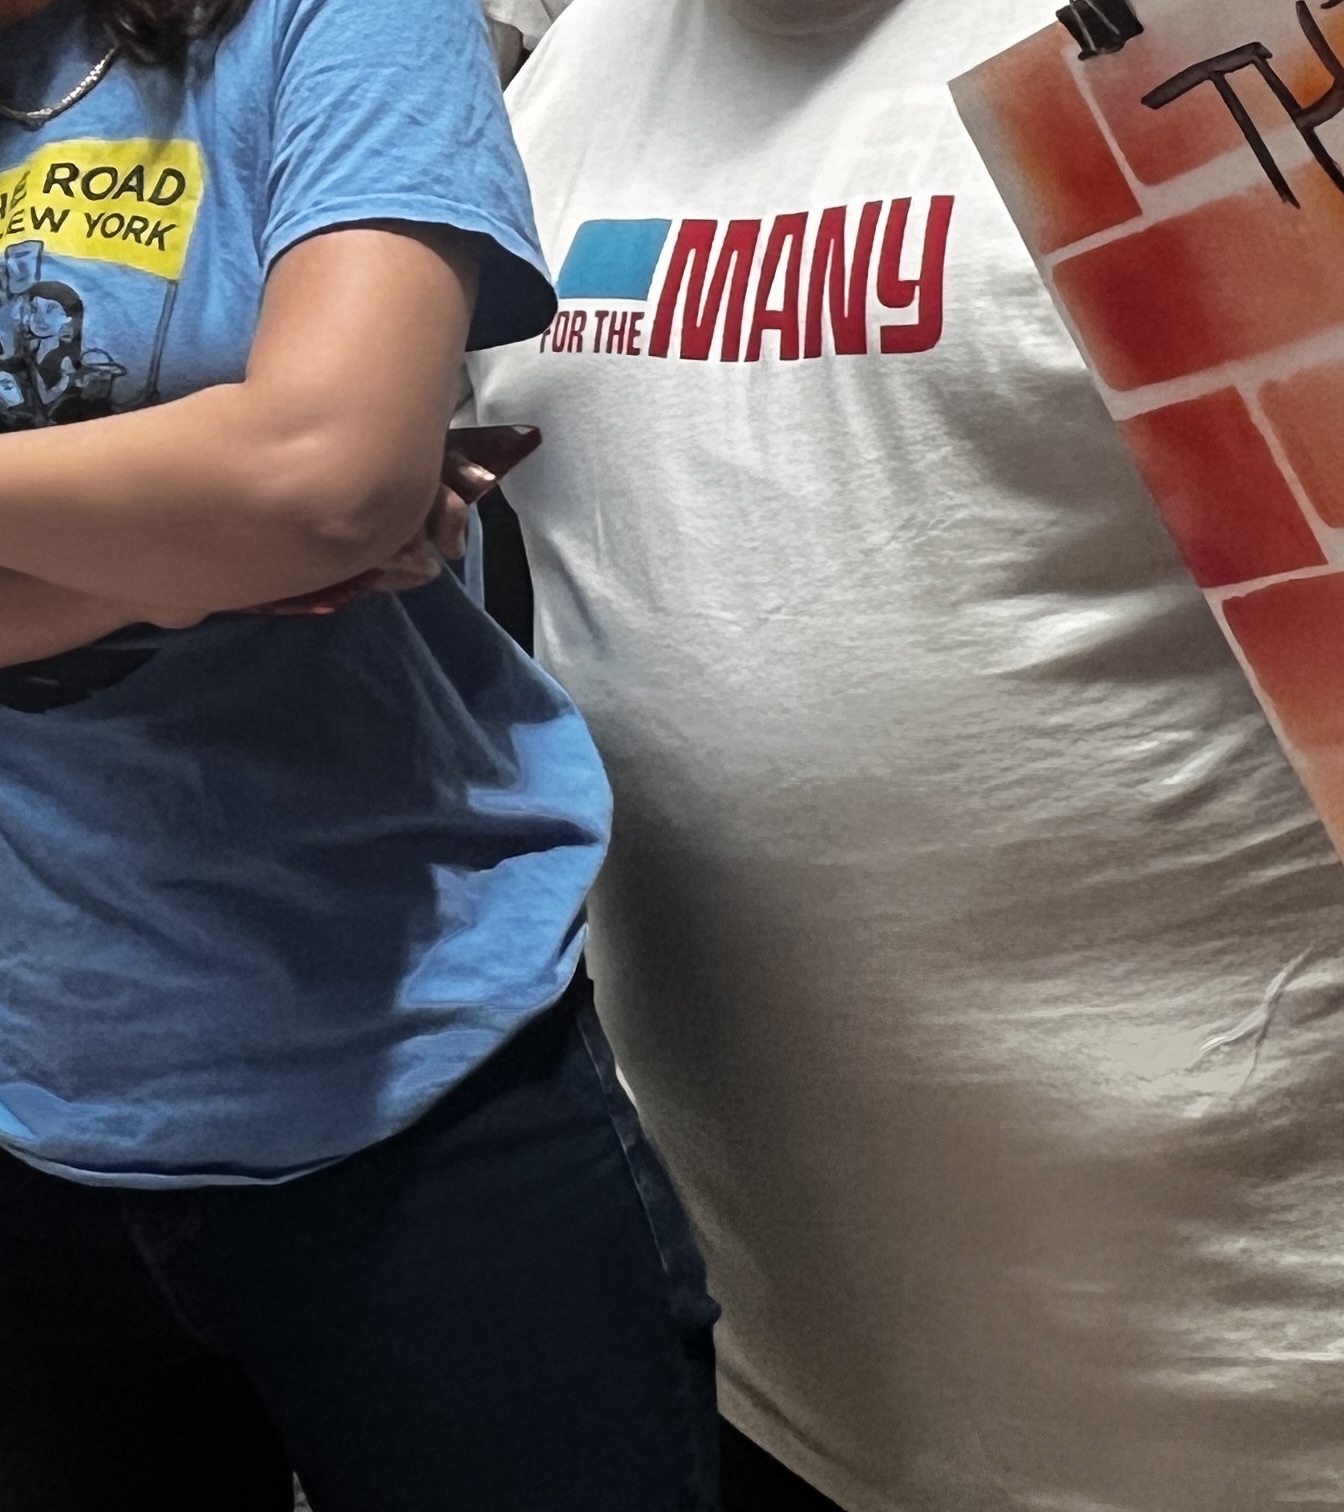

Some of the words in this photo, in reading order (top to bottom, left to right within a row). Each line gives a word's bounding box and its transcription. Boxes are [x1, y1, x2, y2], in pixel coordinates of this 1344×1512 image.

[42, 161, 187, 207] ROAD
[84, 211, 179, 252] YORK
[593, 309, 645, 357] THE
[648, 194, 956, 363] MANY
